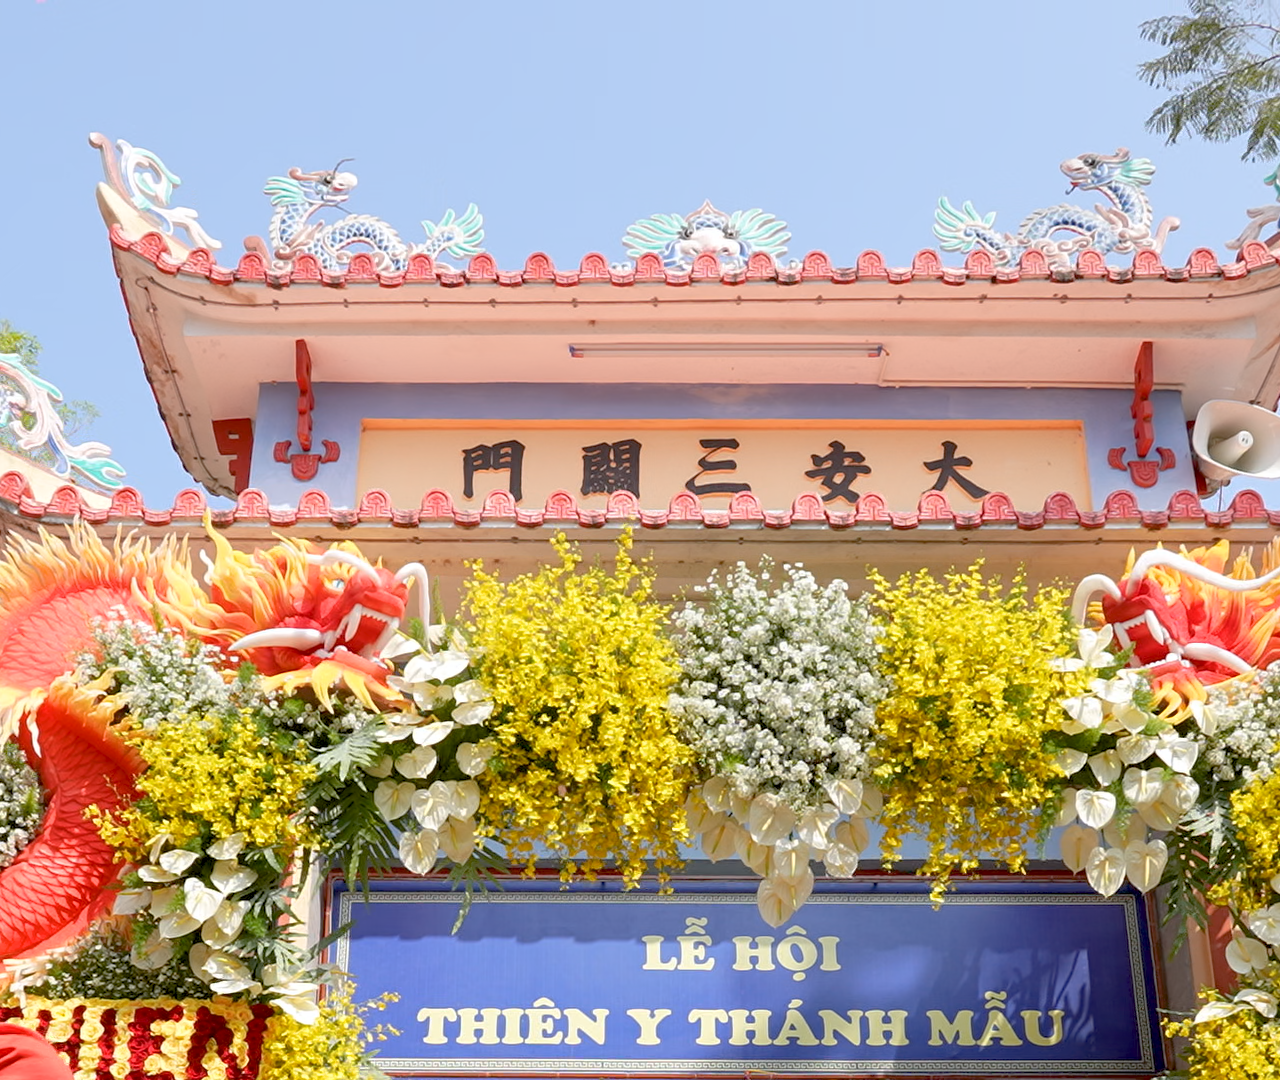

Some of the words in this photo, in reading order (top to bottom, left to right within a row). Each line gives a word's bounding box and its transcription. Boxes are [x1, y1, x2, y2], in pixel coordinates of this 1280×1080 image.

[642, 917, 714, 971] LỄ
[732, 926, 841, 981] HỘI
[417, 997, 609, 1046] THIÊN
[627, 1008, 677, 1046] Y
[688, 998, 908, 1046] THÁNH
[927, 991, 1065, 1046] MẪU
